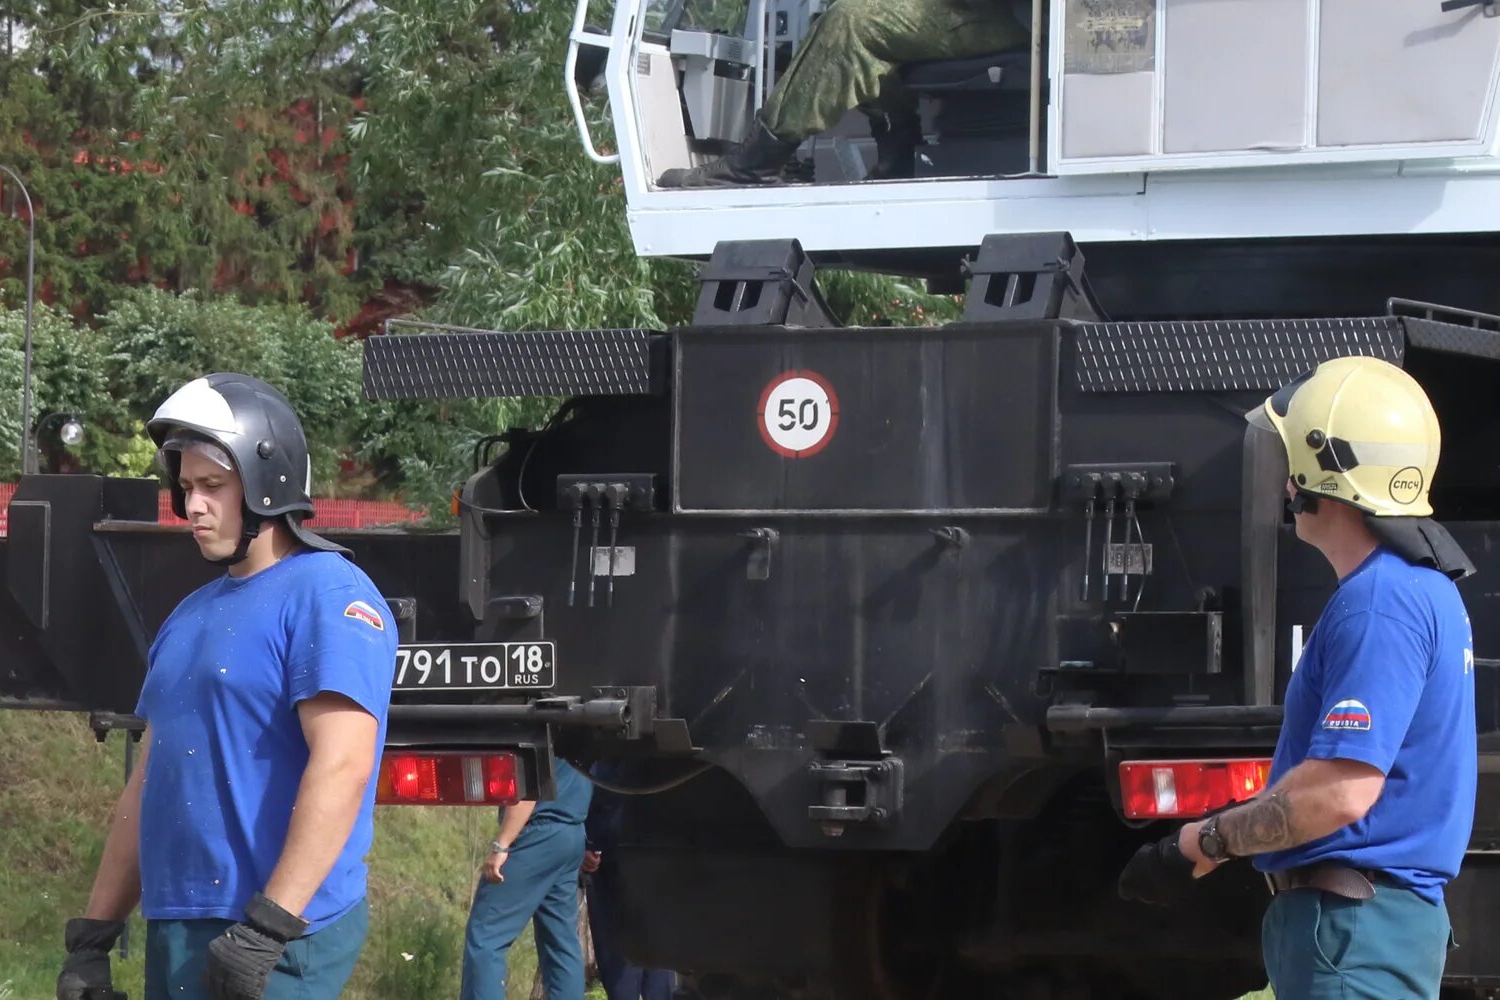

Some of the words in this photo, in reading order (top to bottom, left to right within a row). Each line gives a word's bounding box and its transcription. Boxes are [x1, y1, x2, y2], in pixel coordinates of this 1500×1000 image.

[778, 398, 819, 431] 50
[1393, 480, 1420, 491] СПСЧ
[511, 645, 544, 674] 18
[514, 674, 539, 685] RUS
